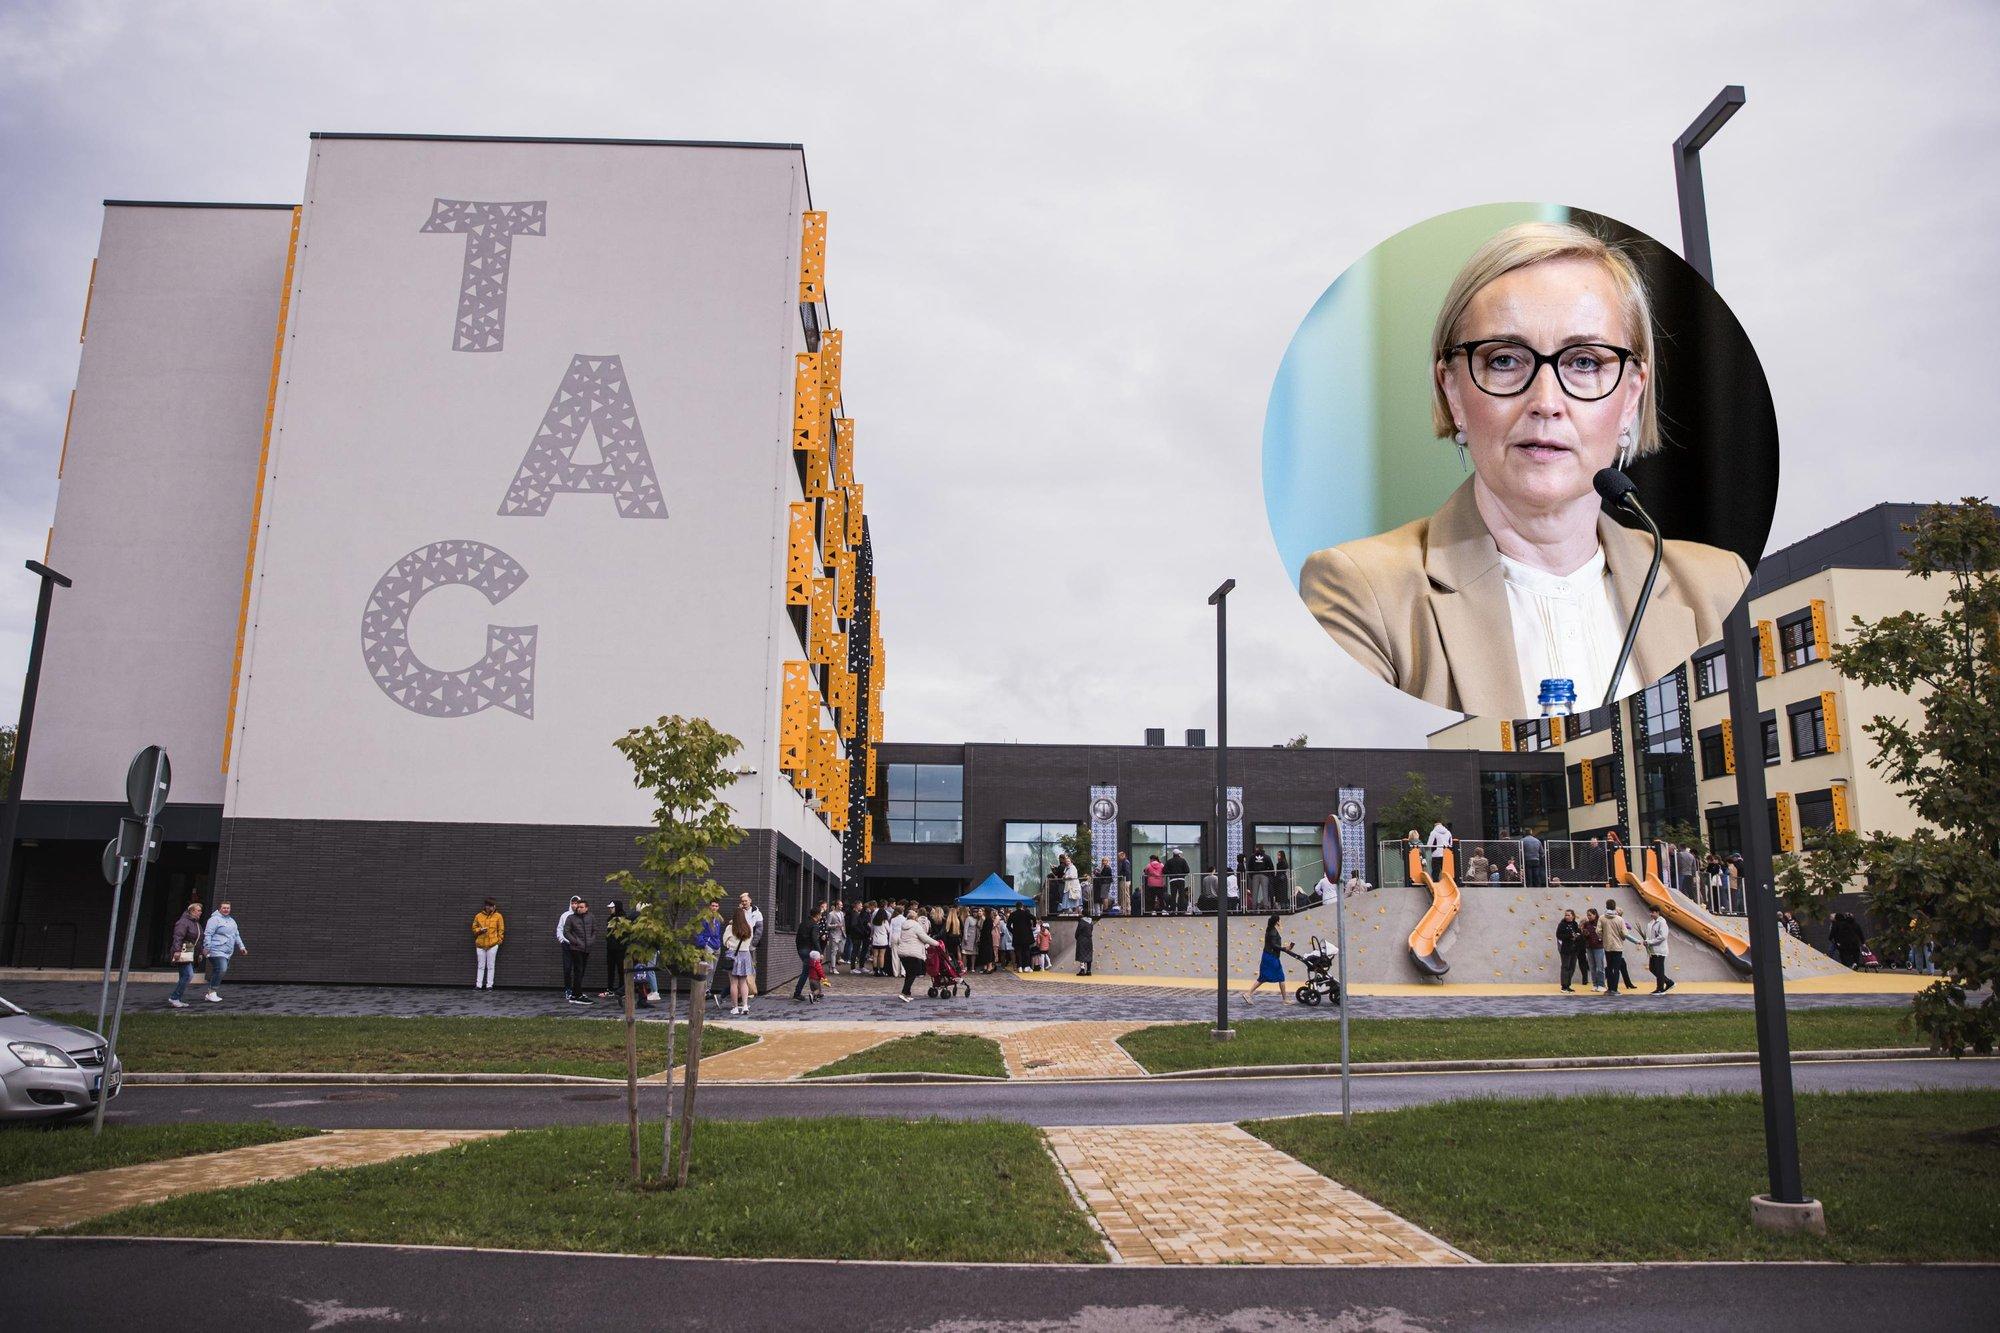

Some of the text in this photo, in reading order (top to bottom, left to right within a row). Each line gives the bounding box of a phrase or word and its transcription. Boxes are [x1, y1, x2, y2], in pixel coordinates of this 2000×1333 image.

[419, 198, 547, 352] T
[497, 354, 669, 519] A
[361, 540, 538, 720] G
